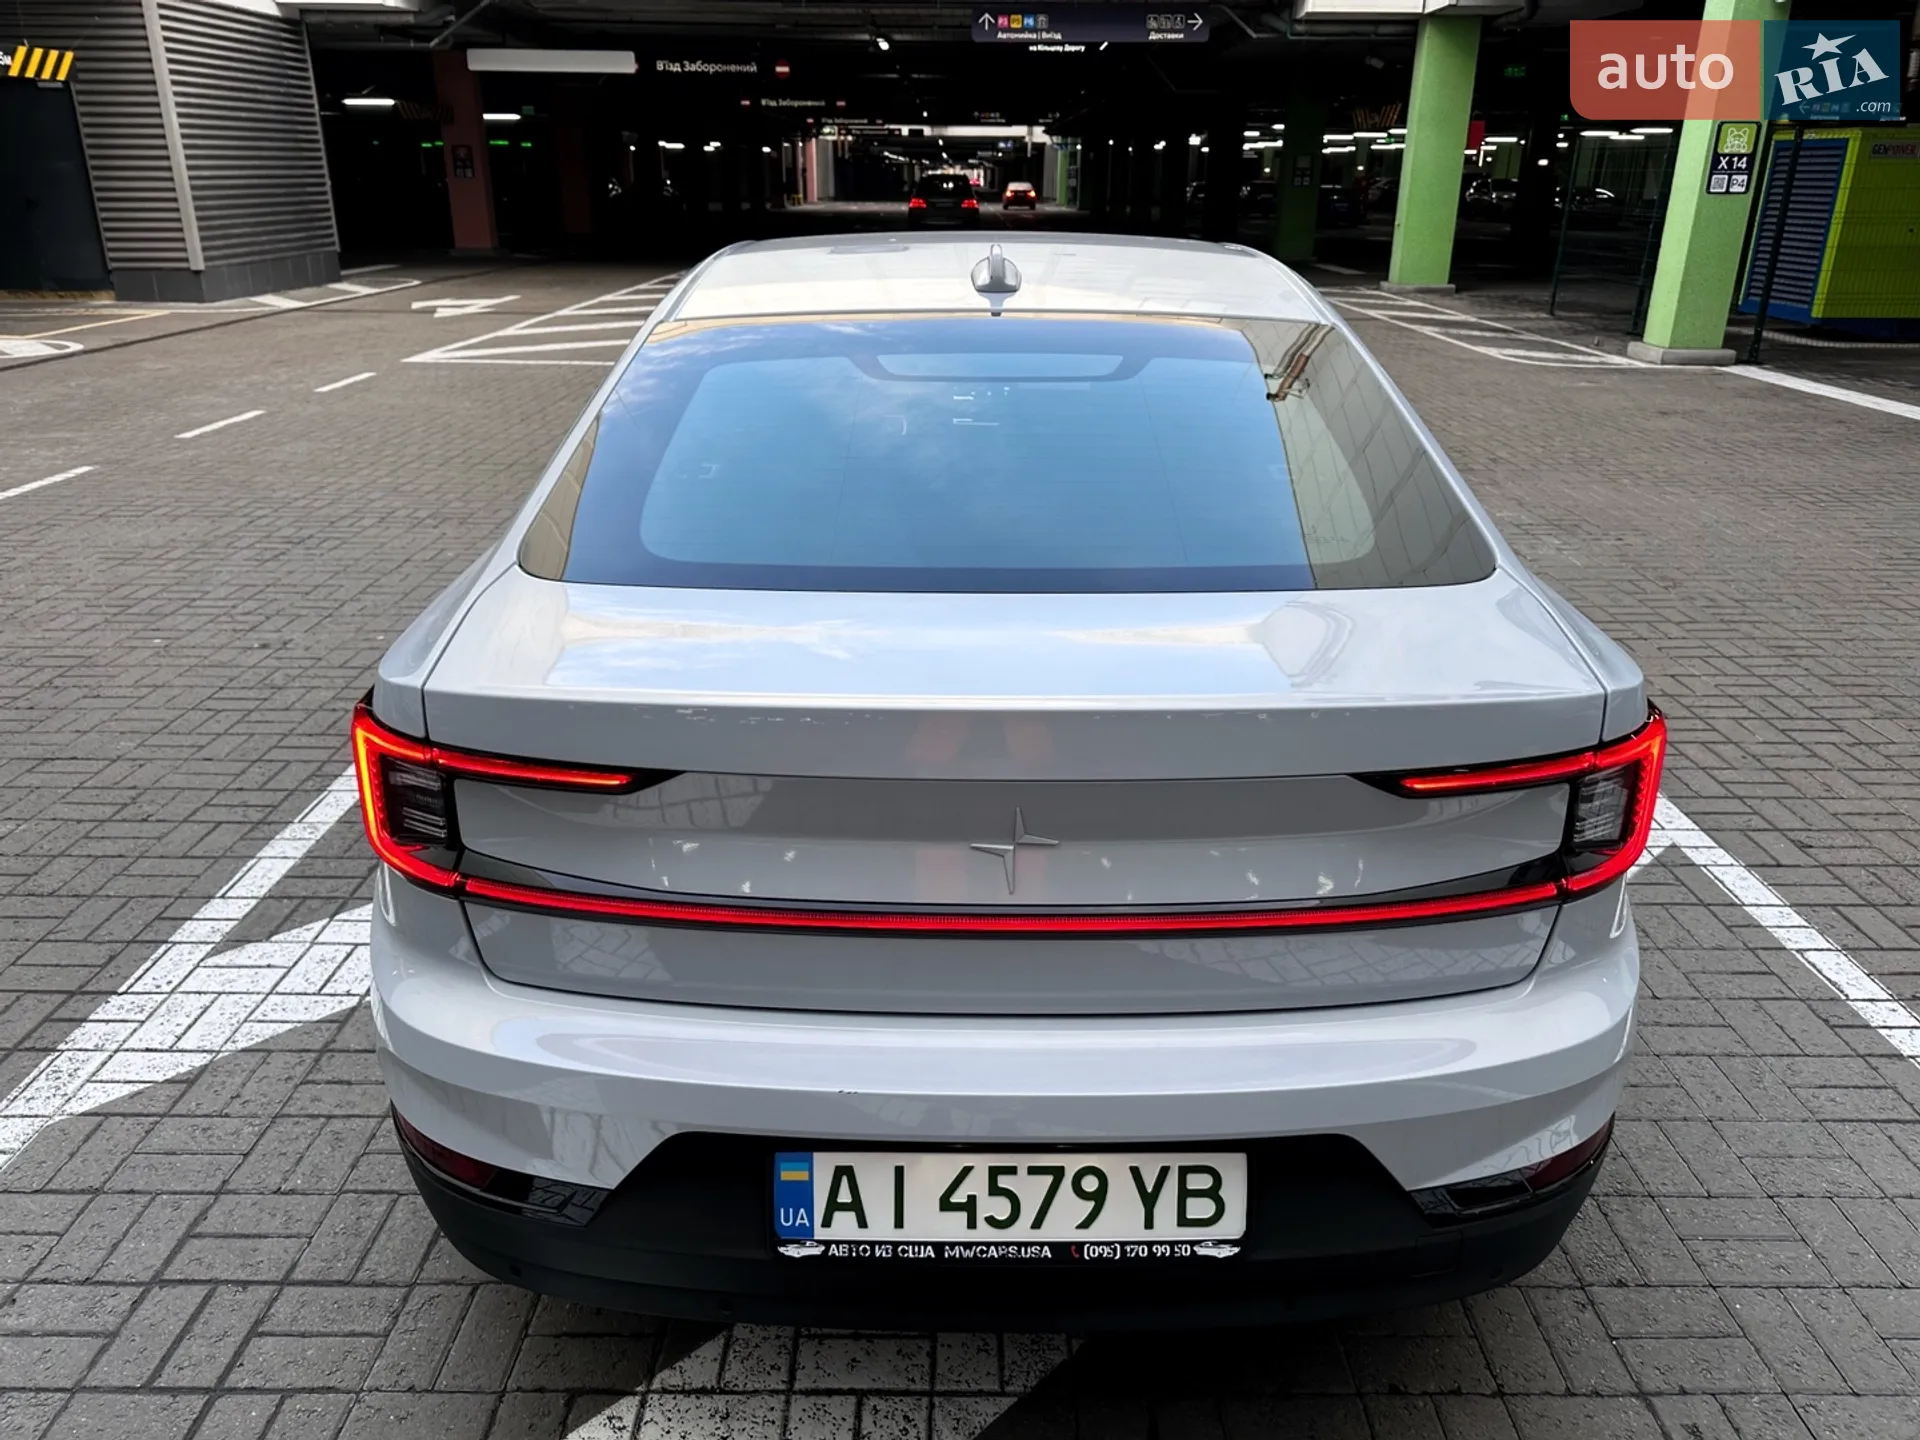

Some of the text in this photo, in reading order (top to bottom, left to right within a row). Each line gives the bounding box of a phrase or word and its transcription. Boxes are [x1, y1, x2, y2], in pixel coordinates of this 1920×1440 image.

[683, 60, 757, 75] Заборонений
[1732, 156, 1748, 170] 14
[1731, 178, 1746, 189] P4
[820, 1164, 1226, 1230] AI 4579 YB
[780, 1207, 810, 1227] UA
[828, 1243, 871, 1257] АВТО
[897, 1244, 936, 1258] США
[1152, 1244, 1170, 1257] 99
